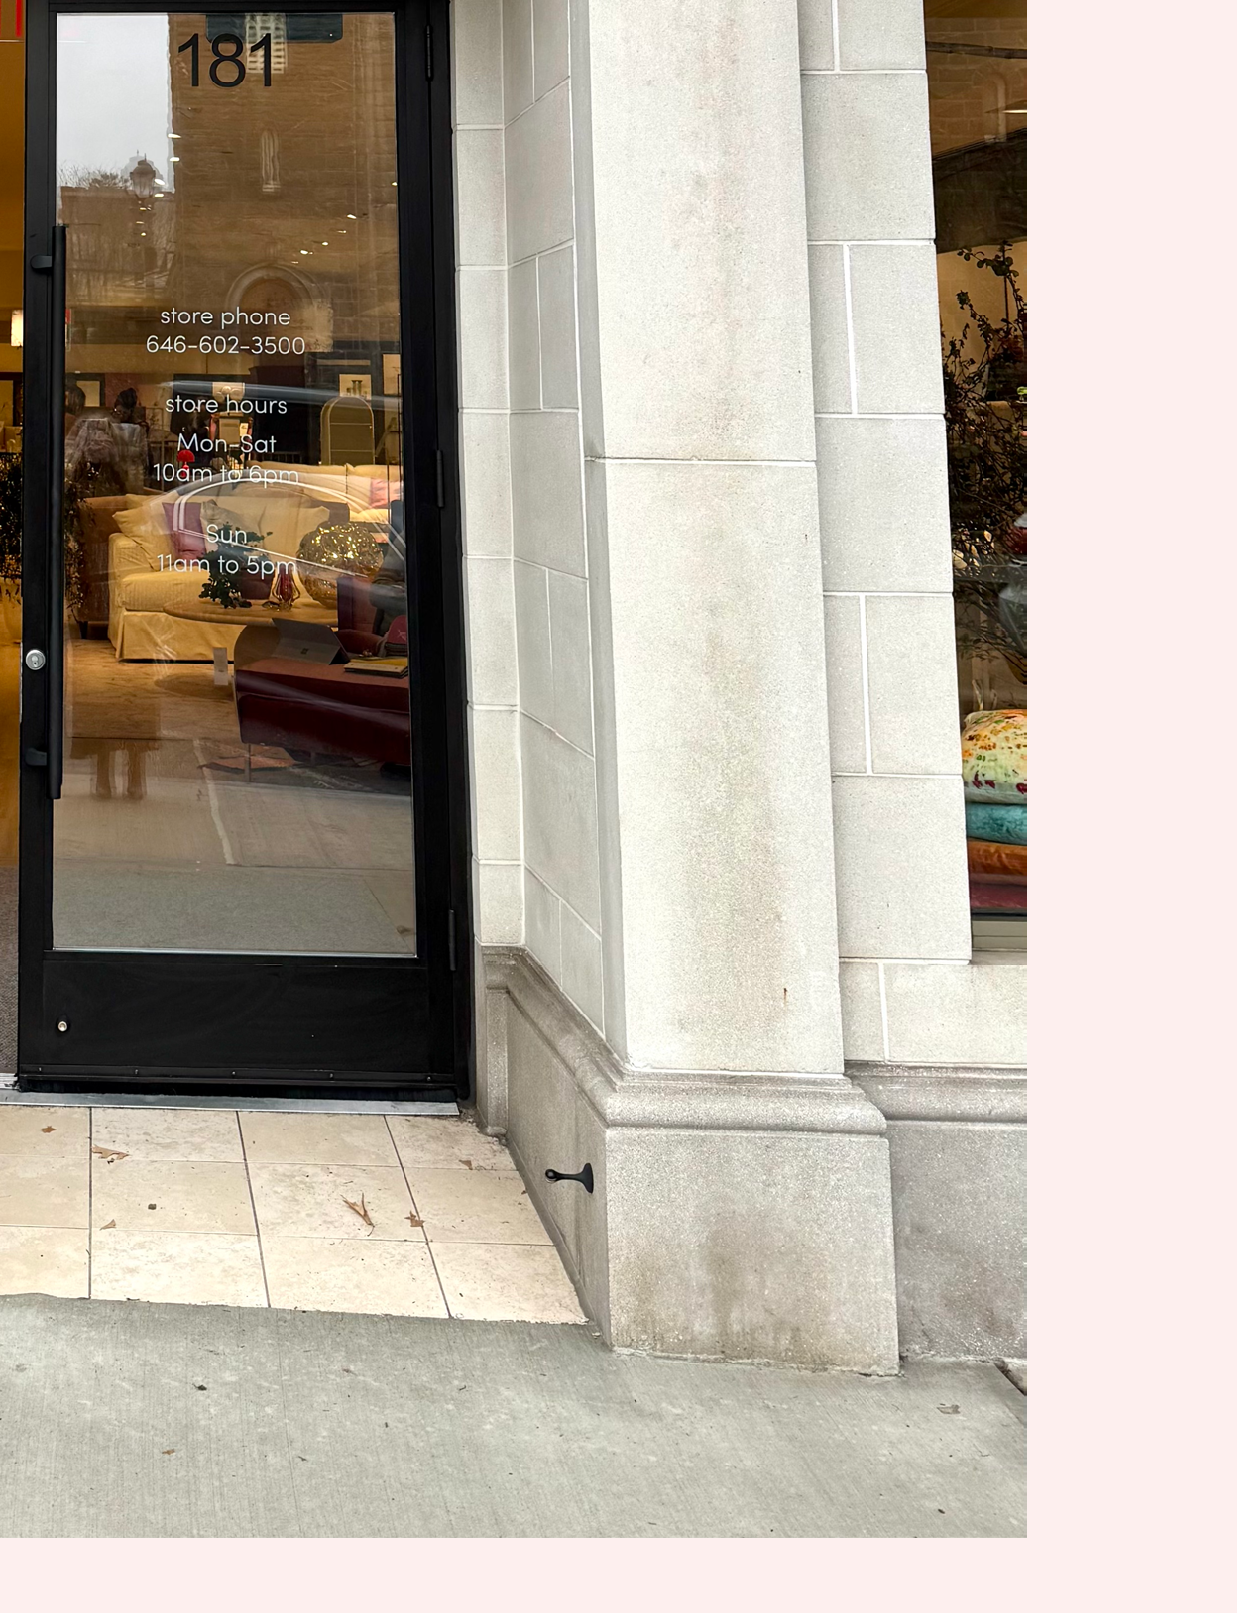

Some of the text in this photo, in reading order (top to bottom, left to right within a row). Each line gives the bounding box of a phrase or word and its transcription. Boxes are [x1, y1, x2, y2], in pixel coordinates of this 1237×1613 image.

[177, 32, 273, 88] 181
[160, 307, 292, 329] store phone
[146, 335, 306, 355] 646-602-3500
[165, 394, 289, 415] store hours
[177, 432, 278, 454] Mon-Sat
[153, 463, 299, 489] 10am to 6pm
[206, 524, 248, 545] Sun
[156, 554, 297, 580] 11am to 5pm
